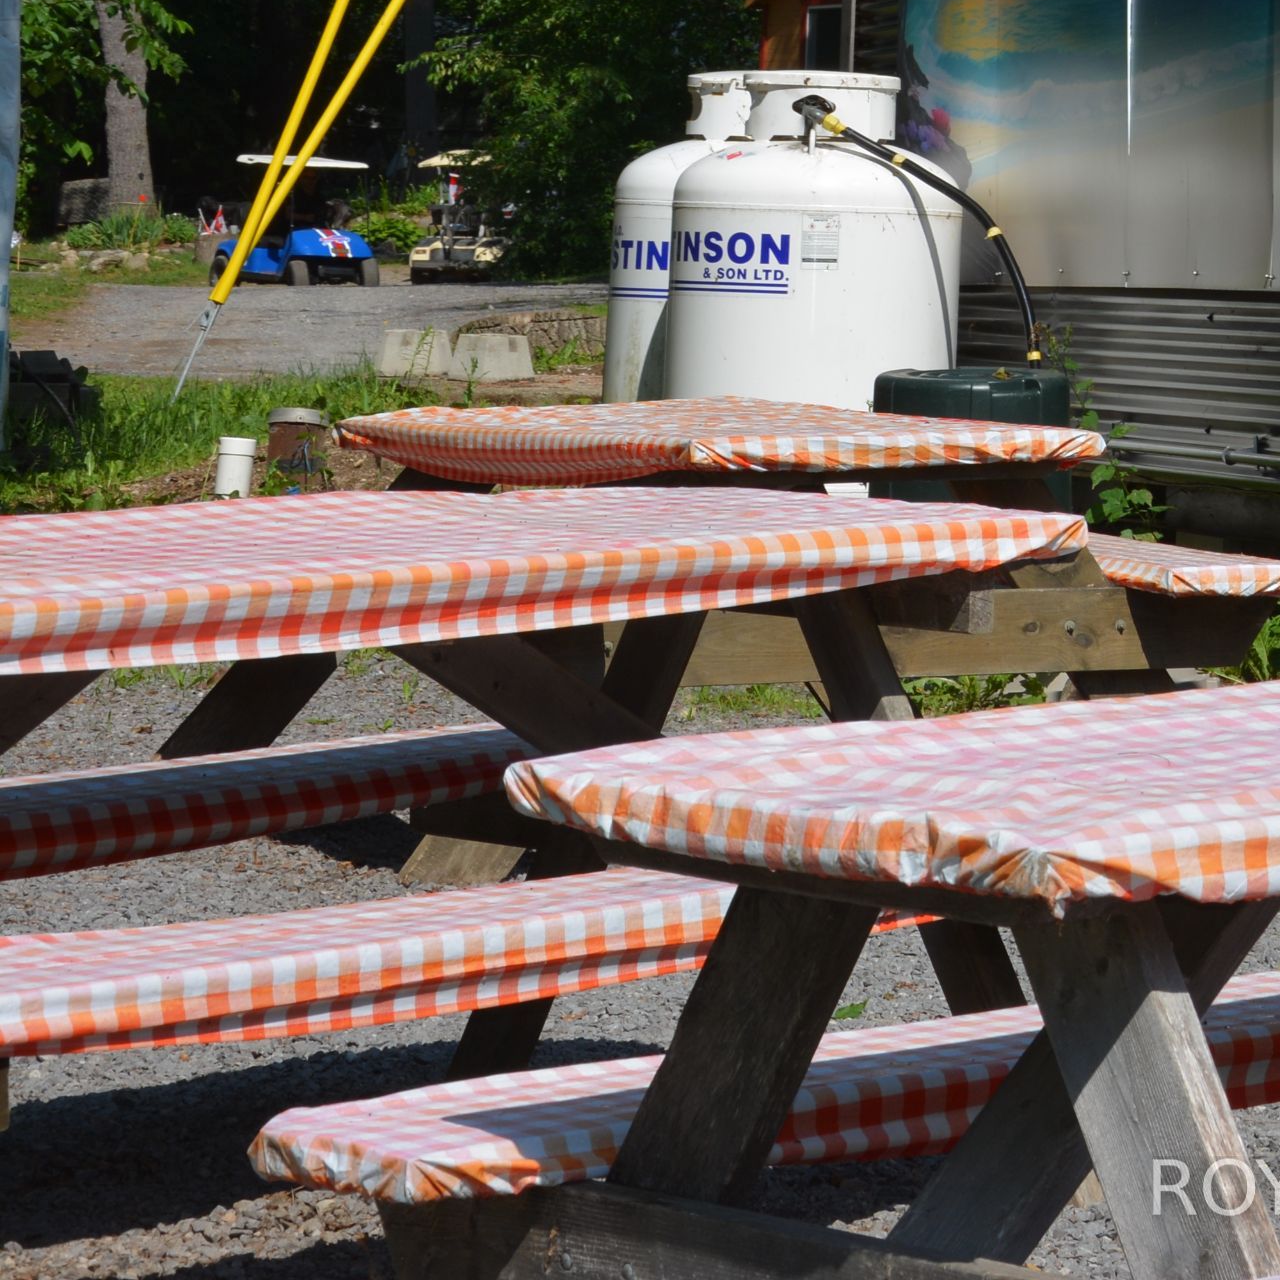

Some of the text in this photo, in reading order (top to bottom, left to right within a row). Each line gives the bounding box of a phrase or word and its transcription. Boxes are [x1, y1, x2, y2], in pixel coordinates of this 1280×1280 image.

[703, 267, 790, 282] & SON LTD.
